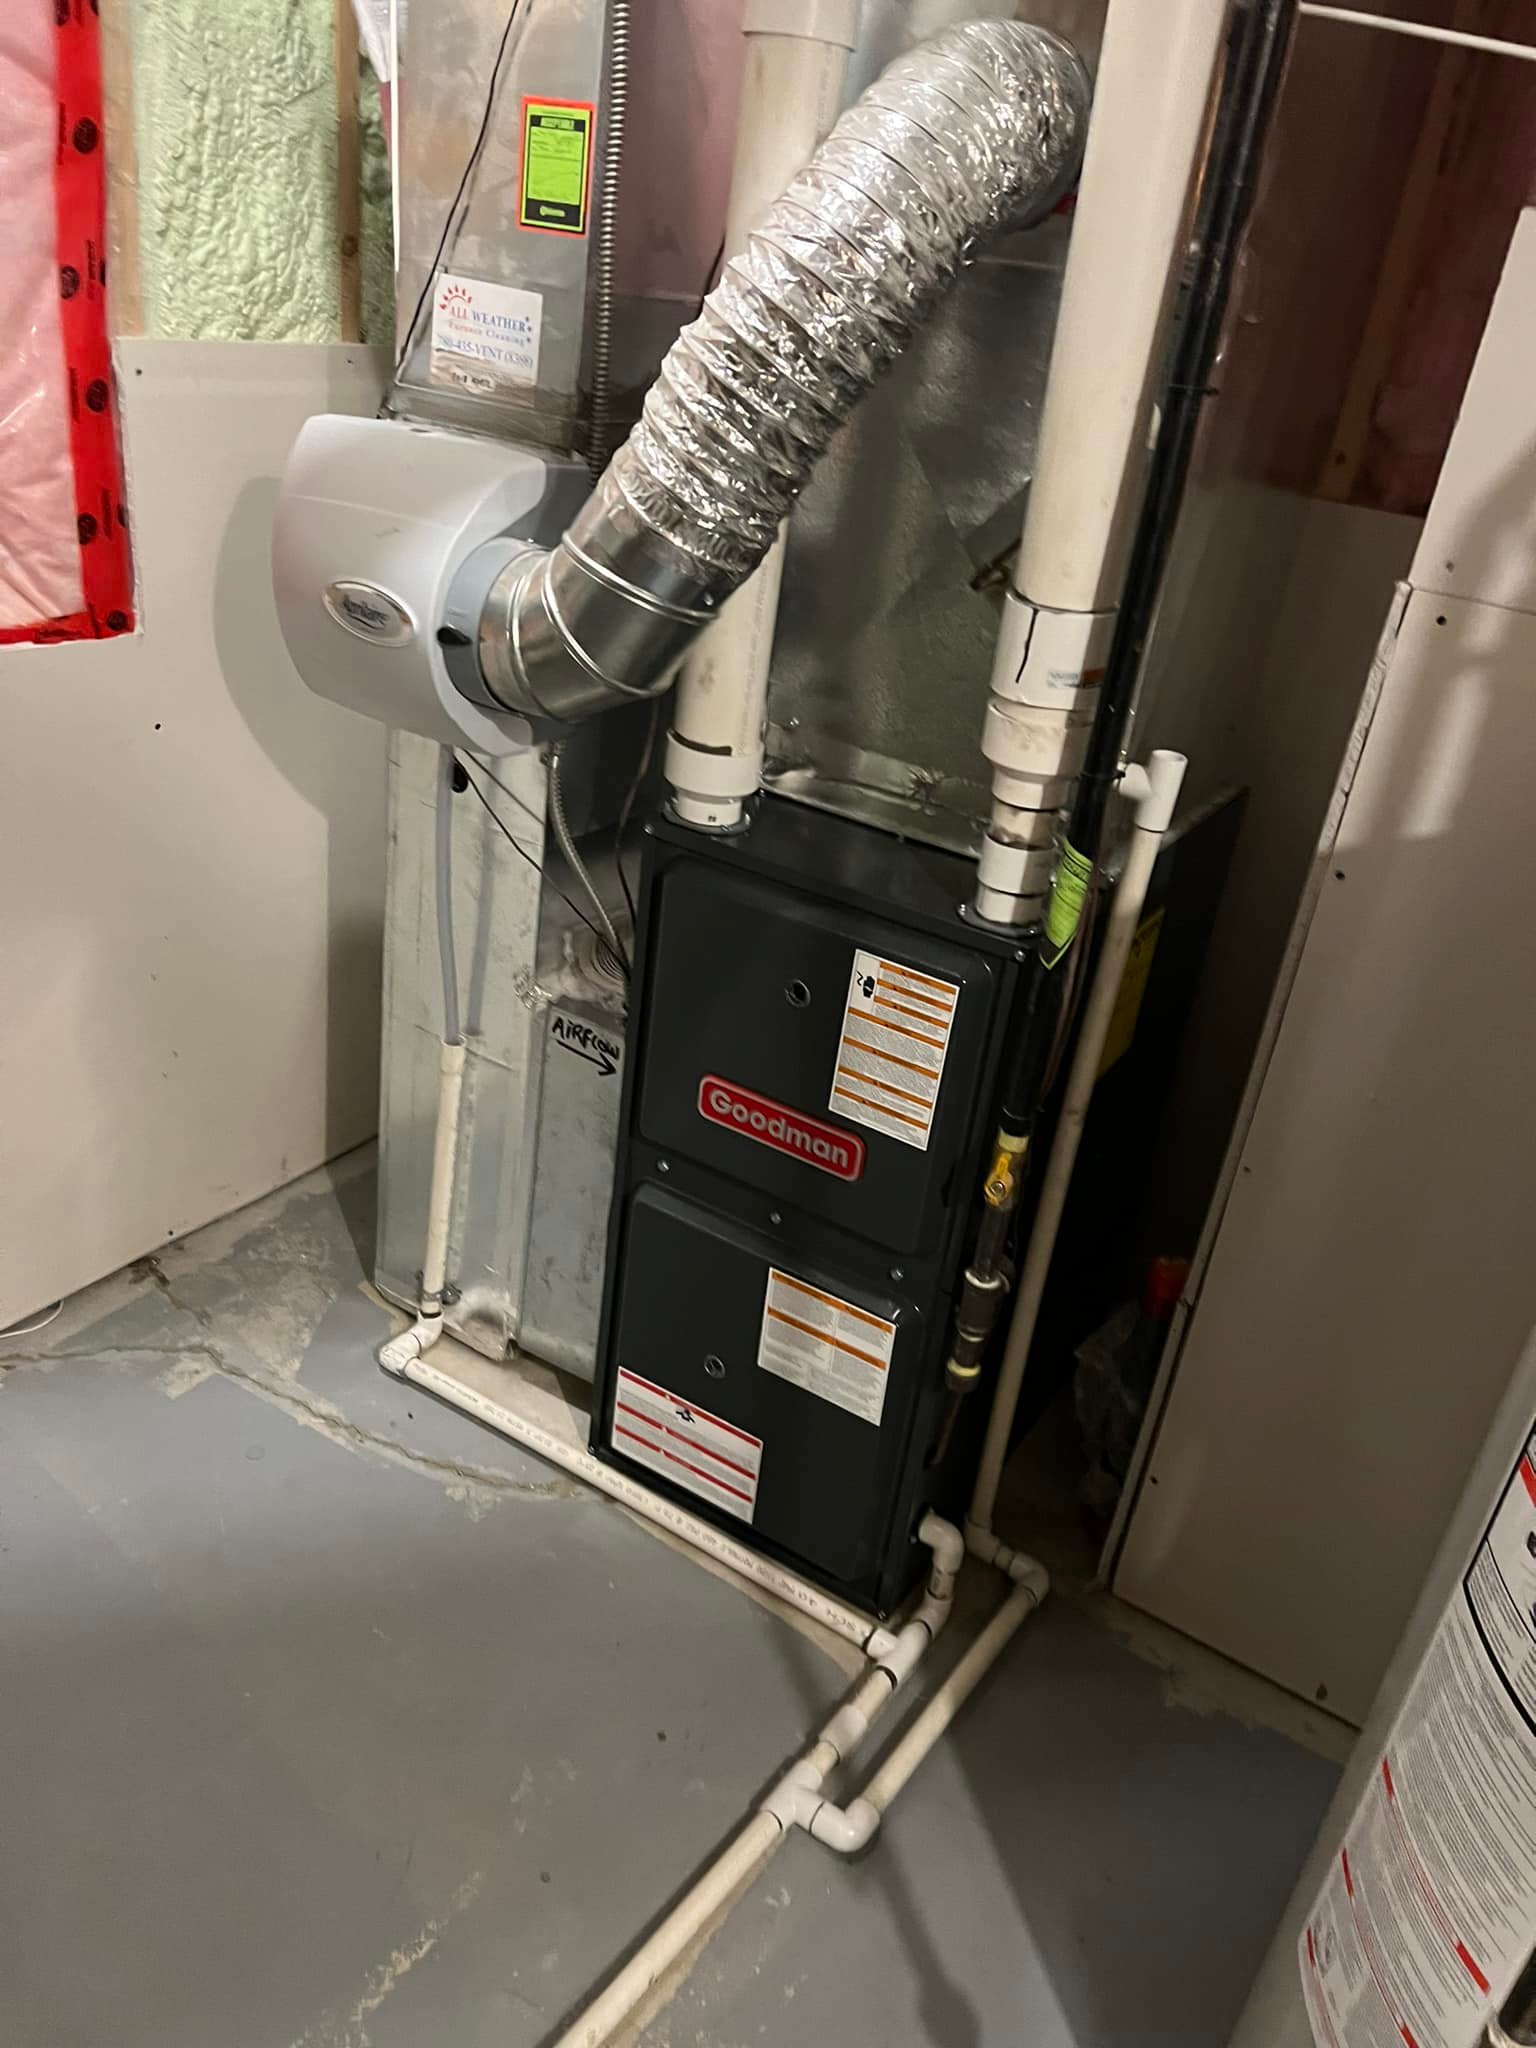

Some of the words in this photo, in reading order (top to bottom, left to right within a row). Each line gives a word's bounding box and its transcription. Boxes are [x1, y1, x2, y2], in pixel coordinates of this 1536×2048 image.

[448, 305, 468, 320] ALL
[471, 310, 526, 333] WEATHER
[709, 1088, 849, 1169] Goodman
